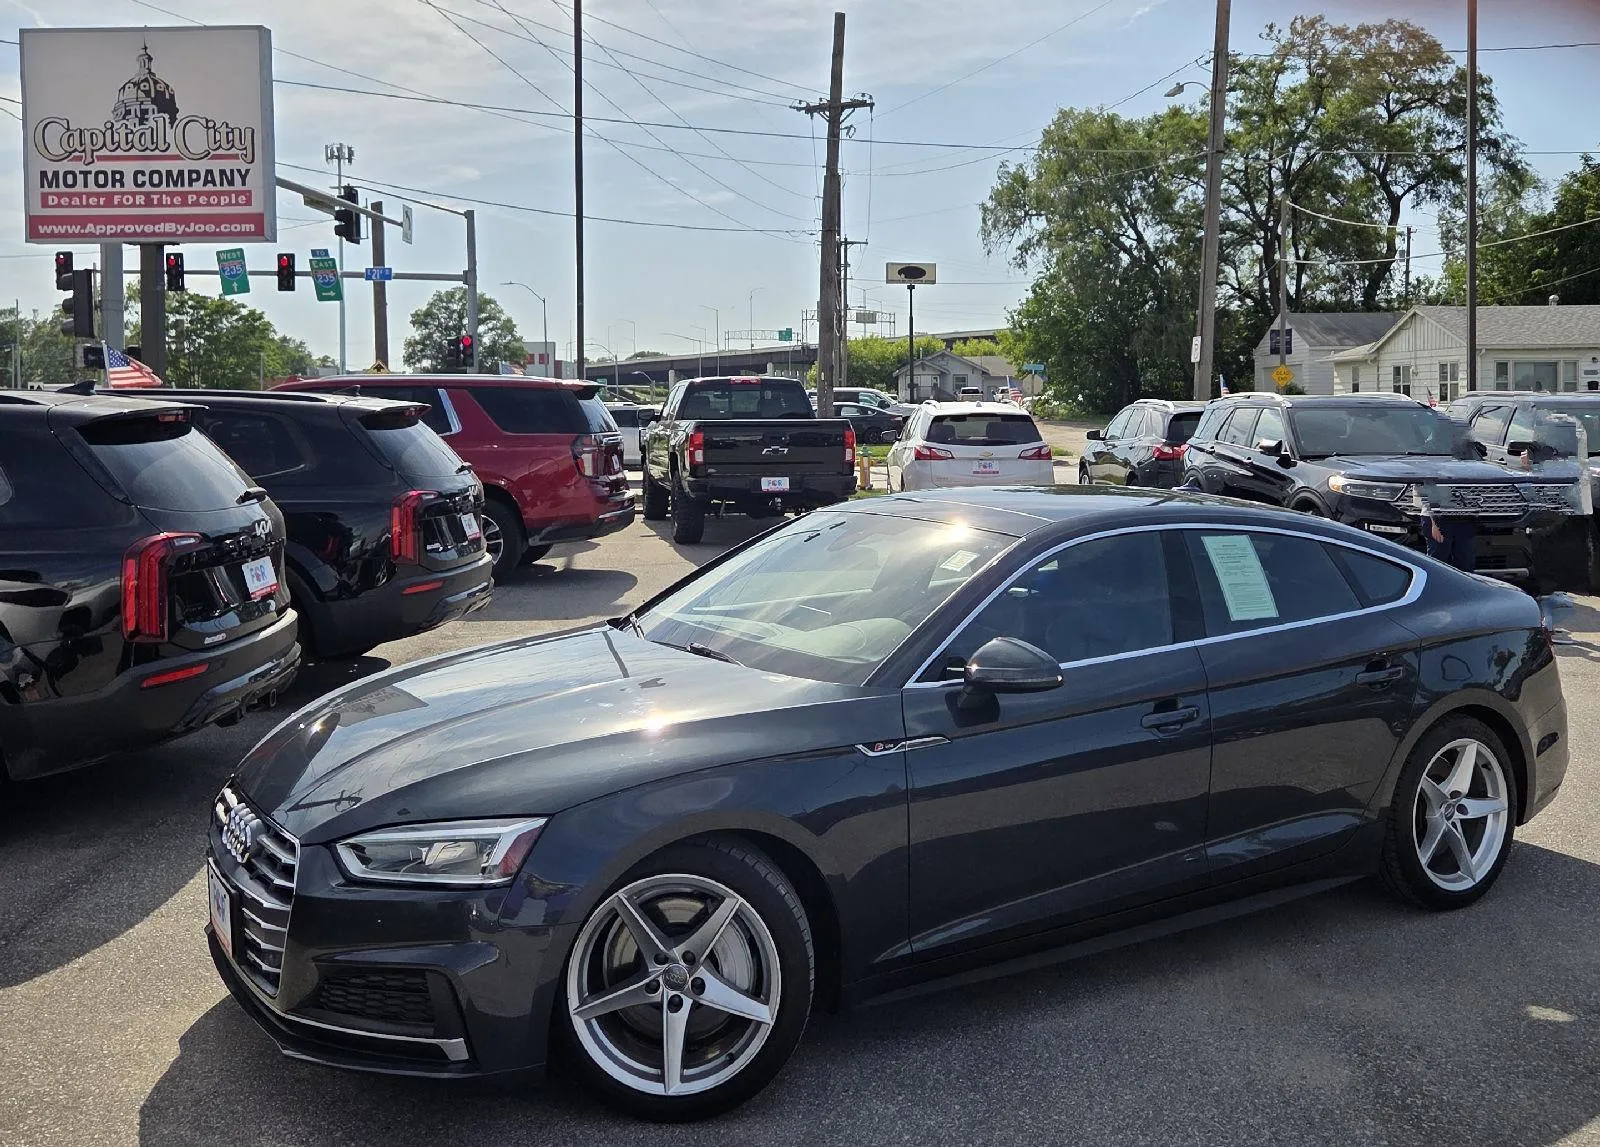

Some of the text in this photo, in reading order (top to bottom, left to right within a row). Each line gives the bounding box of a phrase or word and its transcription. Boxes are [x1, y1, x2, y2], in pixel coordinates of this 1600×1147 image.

[34, 114, 255, 165] Capital City
[40, 168, 251, 189] MOTOR COMPANY
[48, 193, 247, 207] Dealer FOR The People
[38, 222, 255, 235] www.ApprovedByJoe.com
[224, 264, 243, 276] 235
